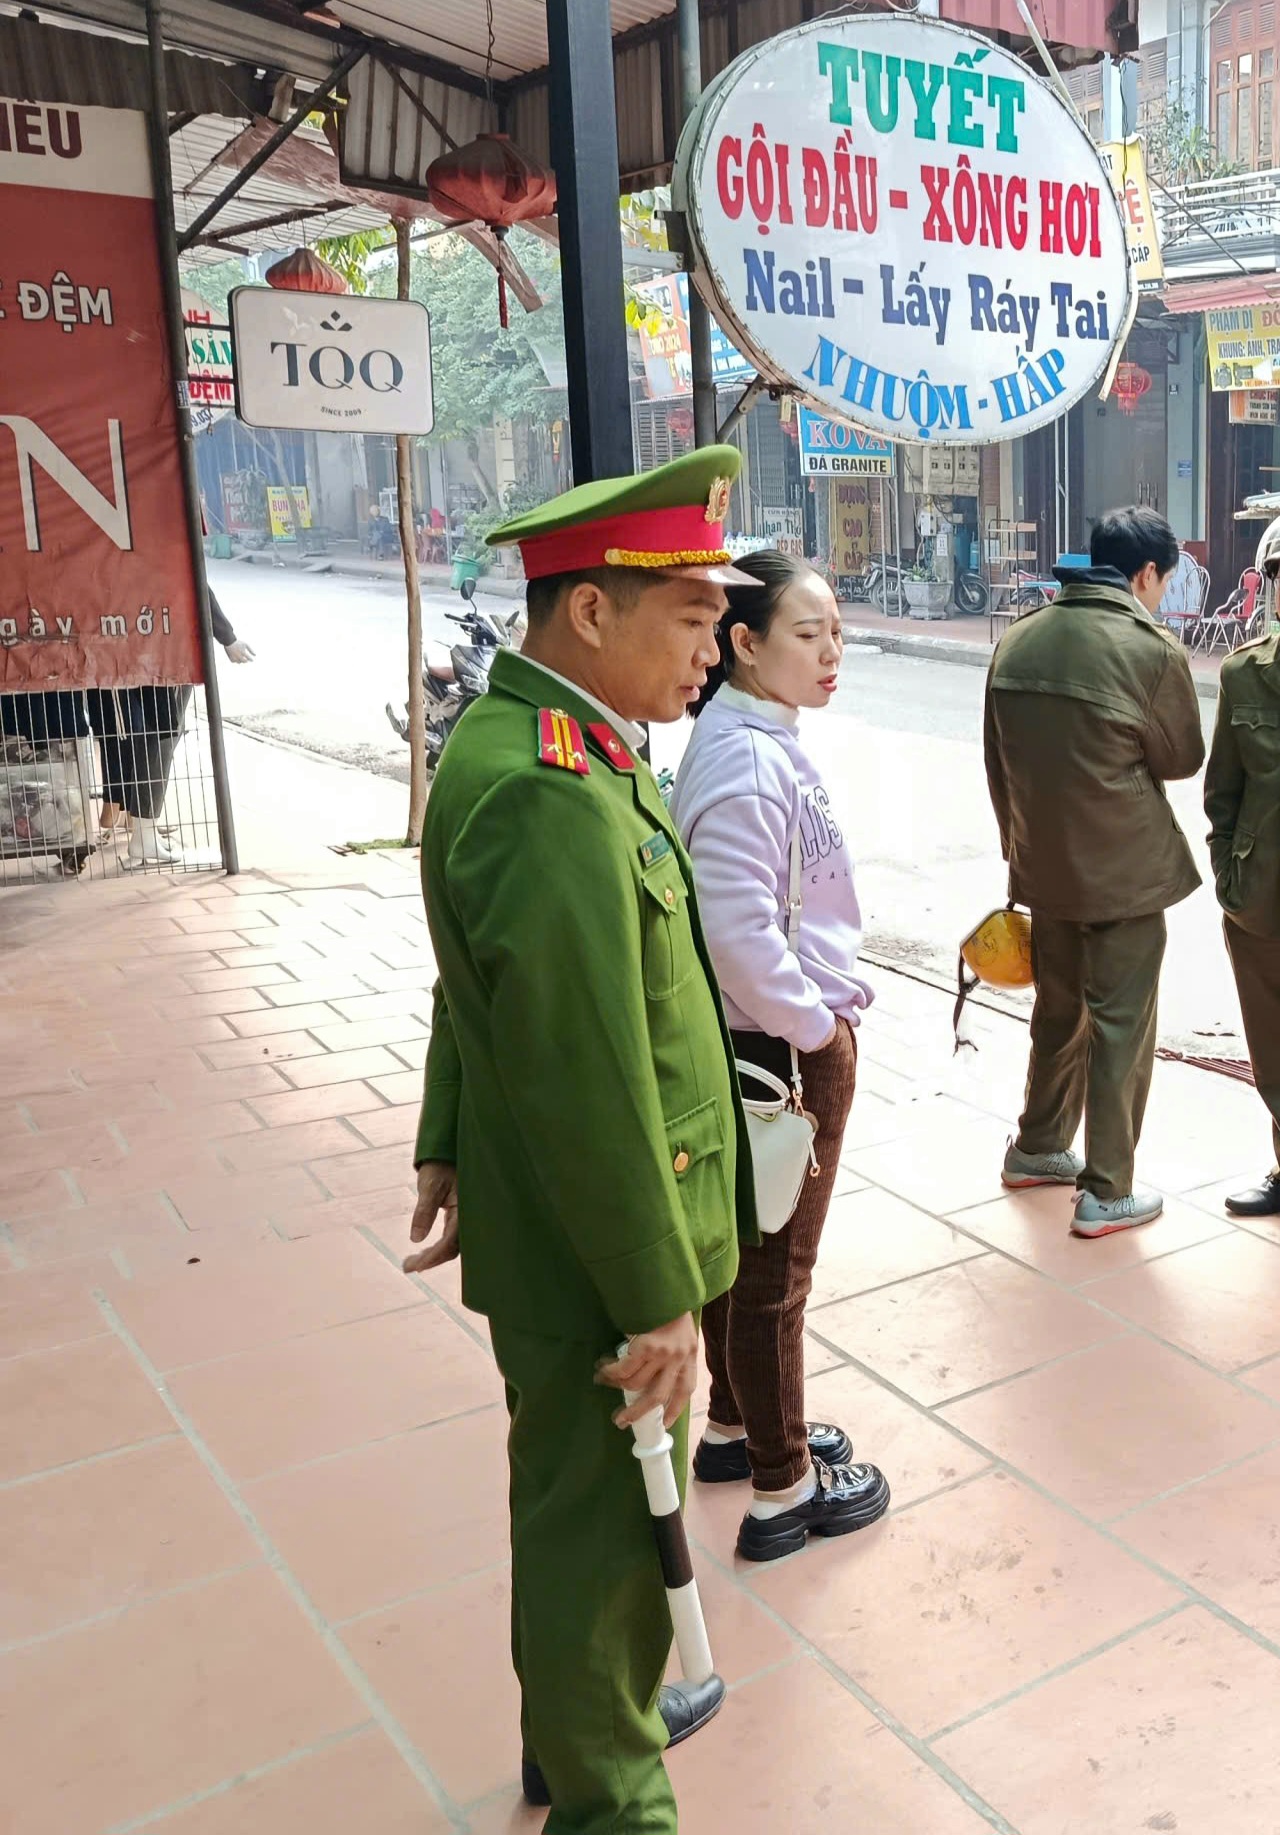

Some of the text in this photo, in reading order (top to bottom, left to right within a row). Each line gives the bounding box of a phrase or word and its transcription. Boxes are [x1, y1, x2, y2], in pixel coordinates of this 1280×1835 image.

[817, 41, 1025, 154] TUYẾT
[716, 122, 794, 236] GỘI
[802, 129, 878, 235] ĐẦU
[920, 154, 1028, 251] XÔNG
[1039, 180, 1102, 258] HƠI
[17, 270, 115, 333] ĐỆM
[743, 248, 835, 319] Nail
[880, 262, 950, 345] Lấy
[968, 278, 1040, 352] Ráy
[1050, 282, 1110, 341] Tai
[1209, 311, 1240, 335] PHẠM
[270, 341, 404, 393] TQQ
[802, 334, 974, 439] NHUỘM
[990, 345, 1067, 423] HẤP
[321, 406, 362, 417] SINCE 2009
[807, 419, 888, 450] KOVA
[809, 454, 888, 473] ĐÁ GRANITE
[99, 604, 172, 637] mới
